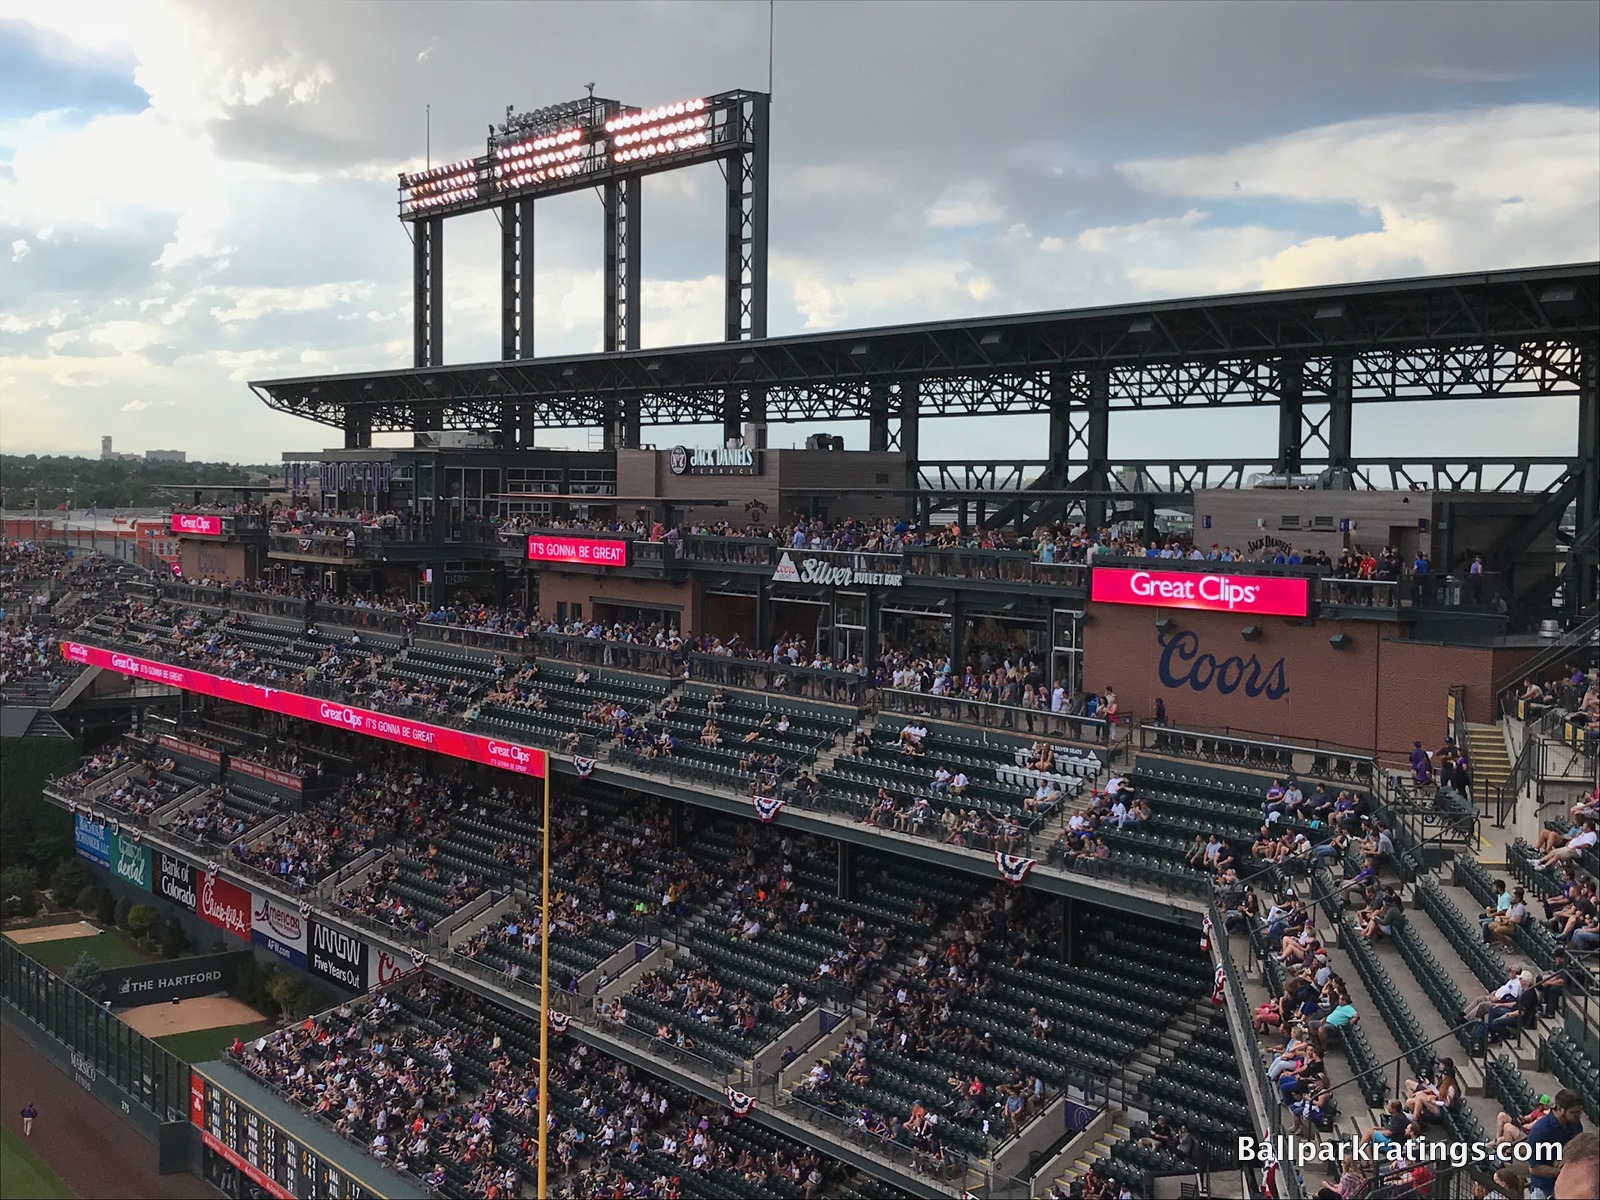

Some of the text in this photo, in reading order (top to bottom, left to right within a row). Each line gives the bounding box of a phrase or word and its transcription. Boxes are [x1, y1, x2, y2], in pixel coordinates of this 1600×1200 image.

[283, 462, 392, 493] THE ROOFTOP
[180, 516, 196, 529] Great
[530, 542, 621, 561] IT'S GONNA BE GREAT
[801, 558, 902, 587] Silver BULLET BAR
[1130, 572, 1256, 609] Great Clips
[112, 654, 127, 669] Great
[1157, 630, 1290, 701] Coors
[320, 703, 434, 744] Great Clips IT'S GONNA BE GREAT
[488, 741, 530, 765] Great Clips
[1054, 745, 1069, 753] SILVER
[161, 854, 190, 883] Bank of
[161, 874, 197, 908] Colorado
[267, 939, 291, 959] AFW.com
[131, 970, 222, 993] THE HARTFORD
[314, 953, 360, 989] Five Years Out
[286, 1152, 297, 1169] MIL
[287, 1166, 294, 1181] SD
[287, 1180, 293, 1193] SF
